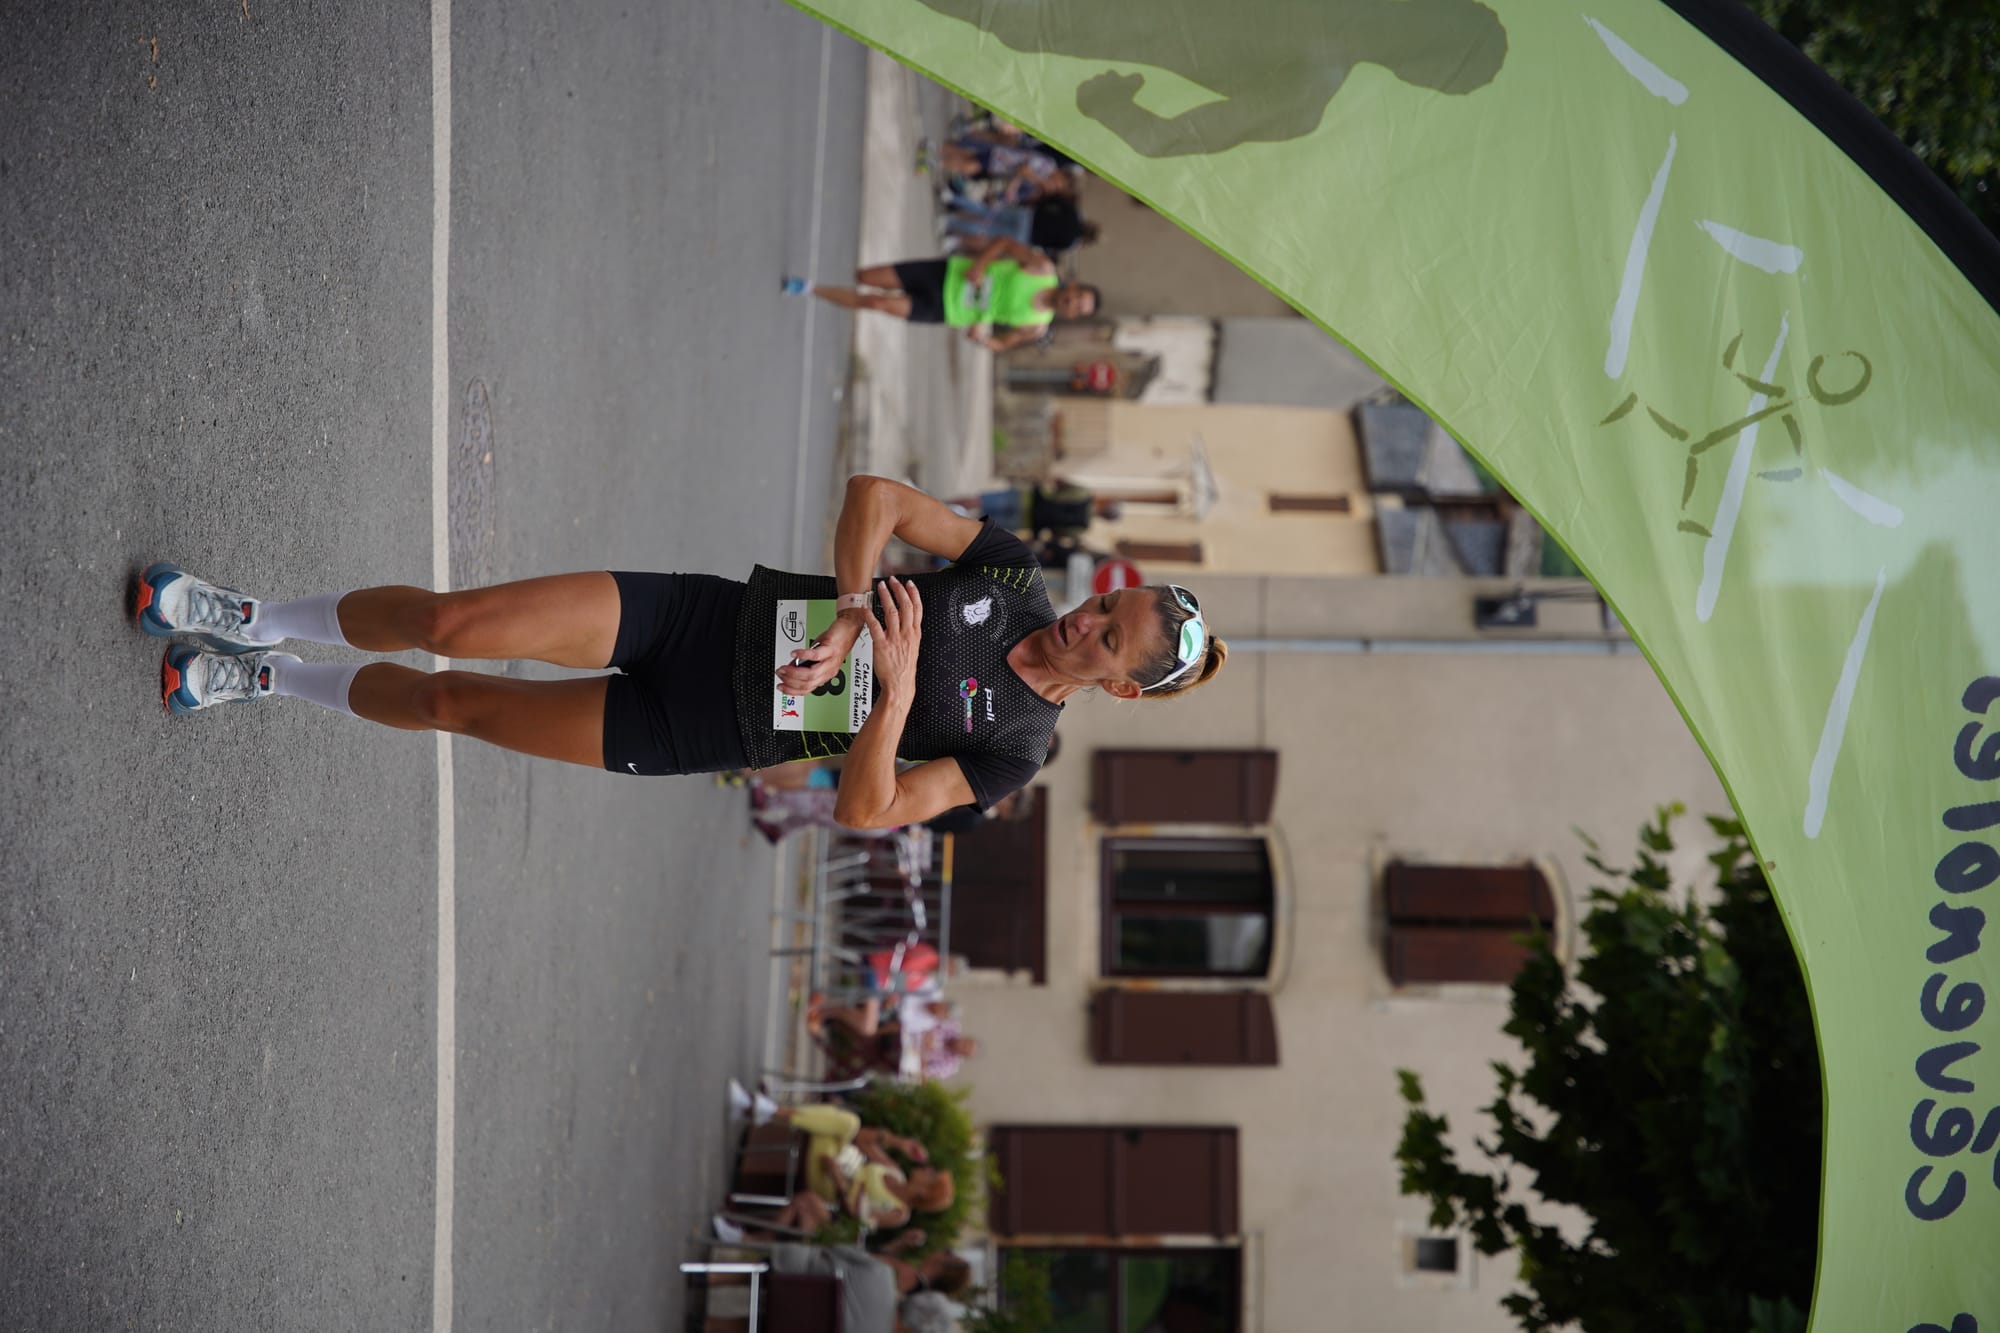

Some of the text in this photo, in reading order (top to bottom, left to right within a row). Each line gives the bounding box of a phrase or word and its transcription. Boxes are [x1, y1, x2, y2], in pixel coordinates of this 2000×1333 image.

[788, 611, 797, 638] BFP
[853, 658, 862, 728] vallées cévenoles
[860, 663, 870, 705] Challenge
[984, 687, 995, 721] poli
